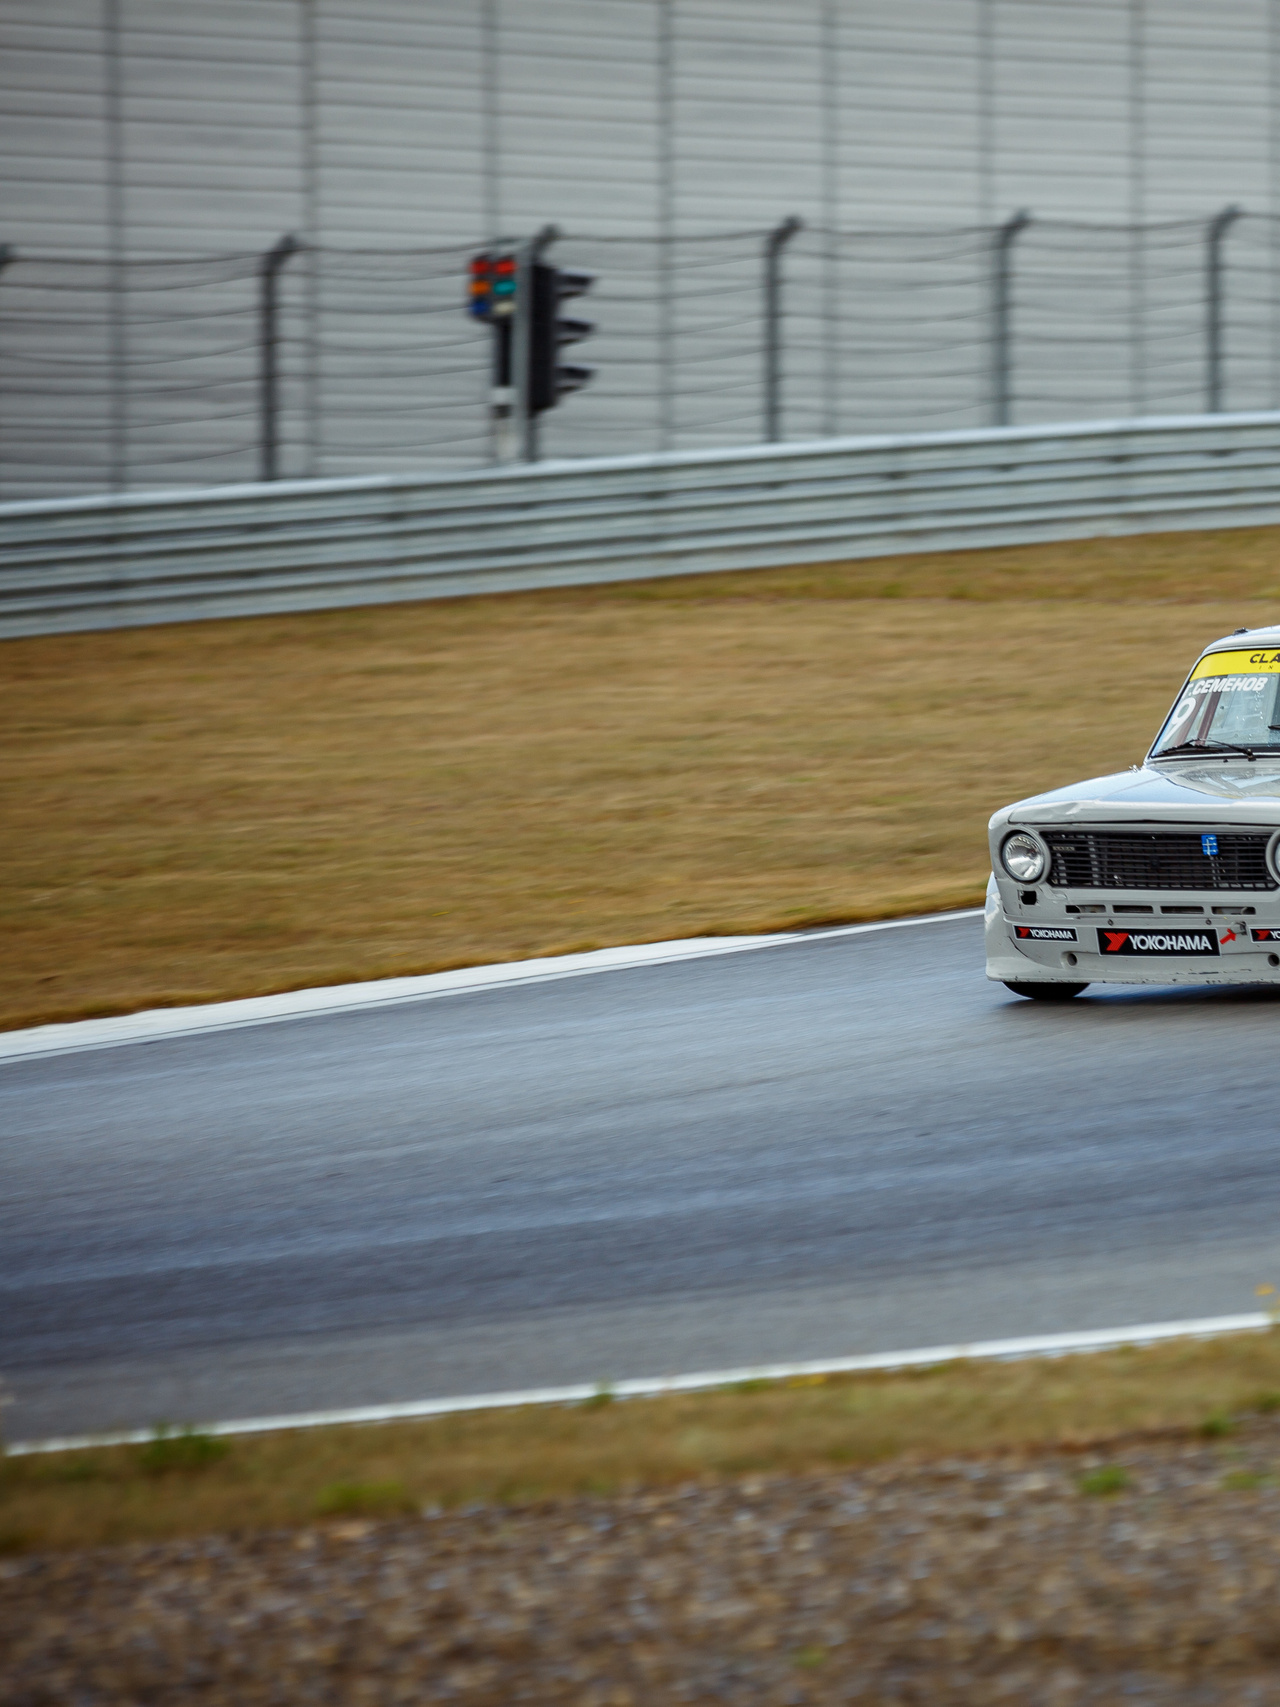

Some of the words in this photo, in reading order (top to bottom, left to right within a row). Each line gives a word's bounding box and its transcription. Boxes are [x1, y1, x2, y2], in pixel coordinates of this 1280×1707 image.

[1162, 697, 1197, 743] 9
[1029, 928, 1074, 939] YOKOHAMA
[1128, 934, 1213, 951] YOKOHAMA
